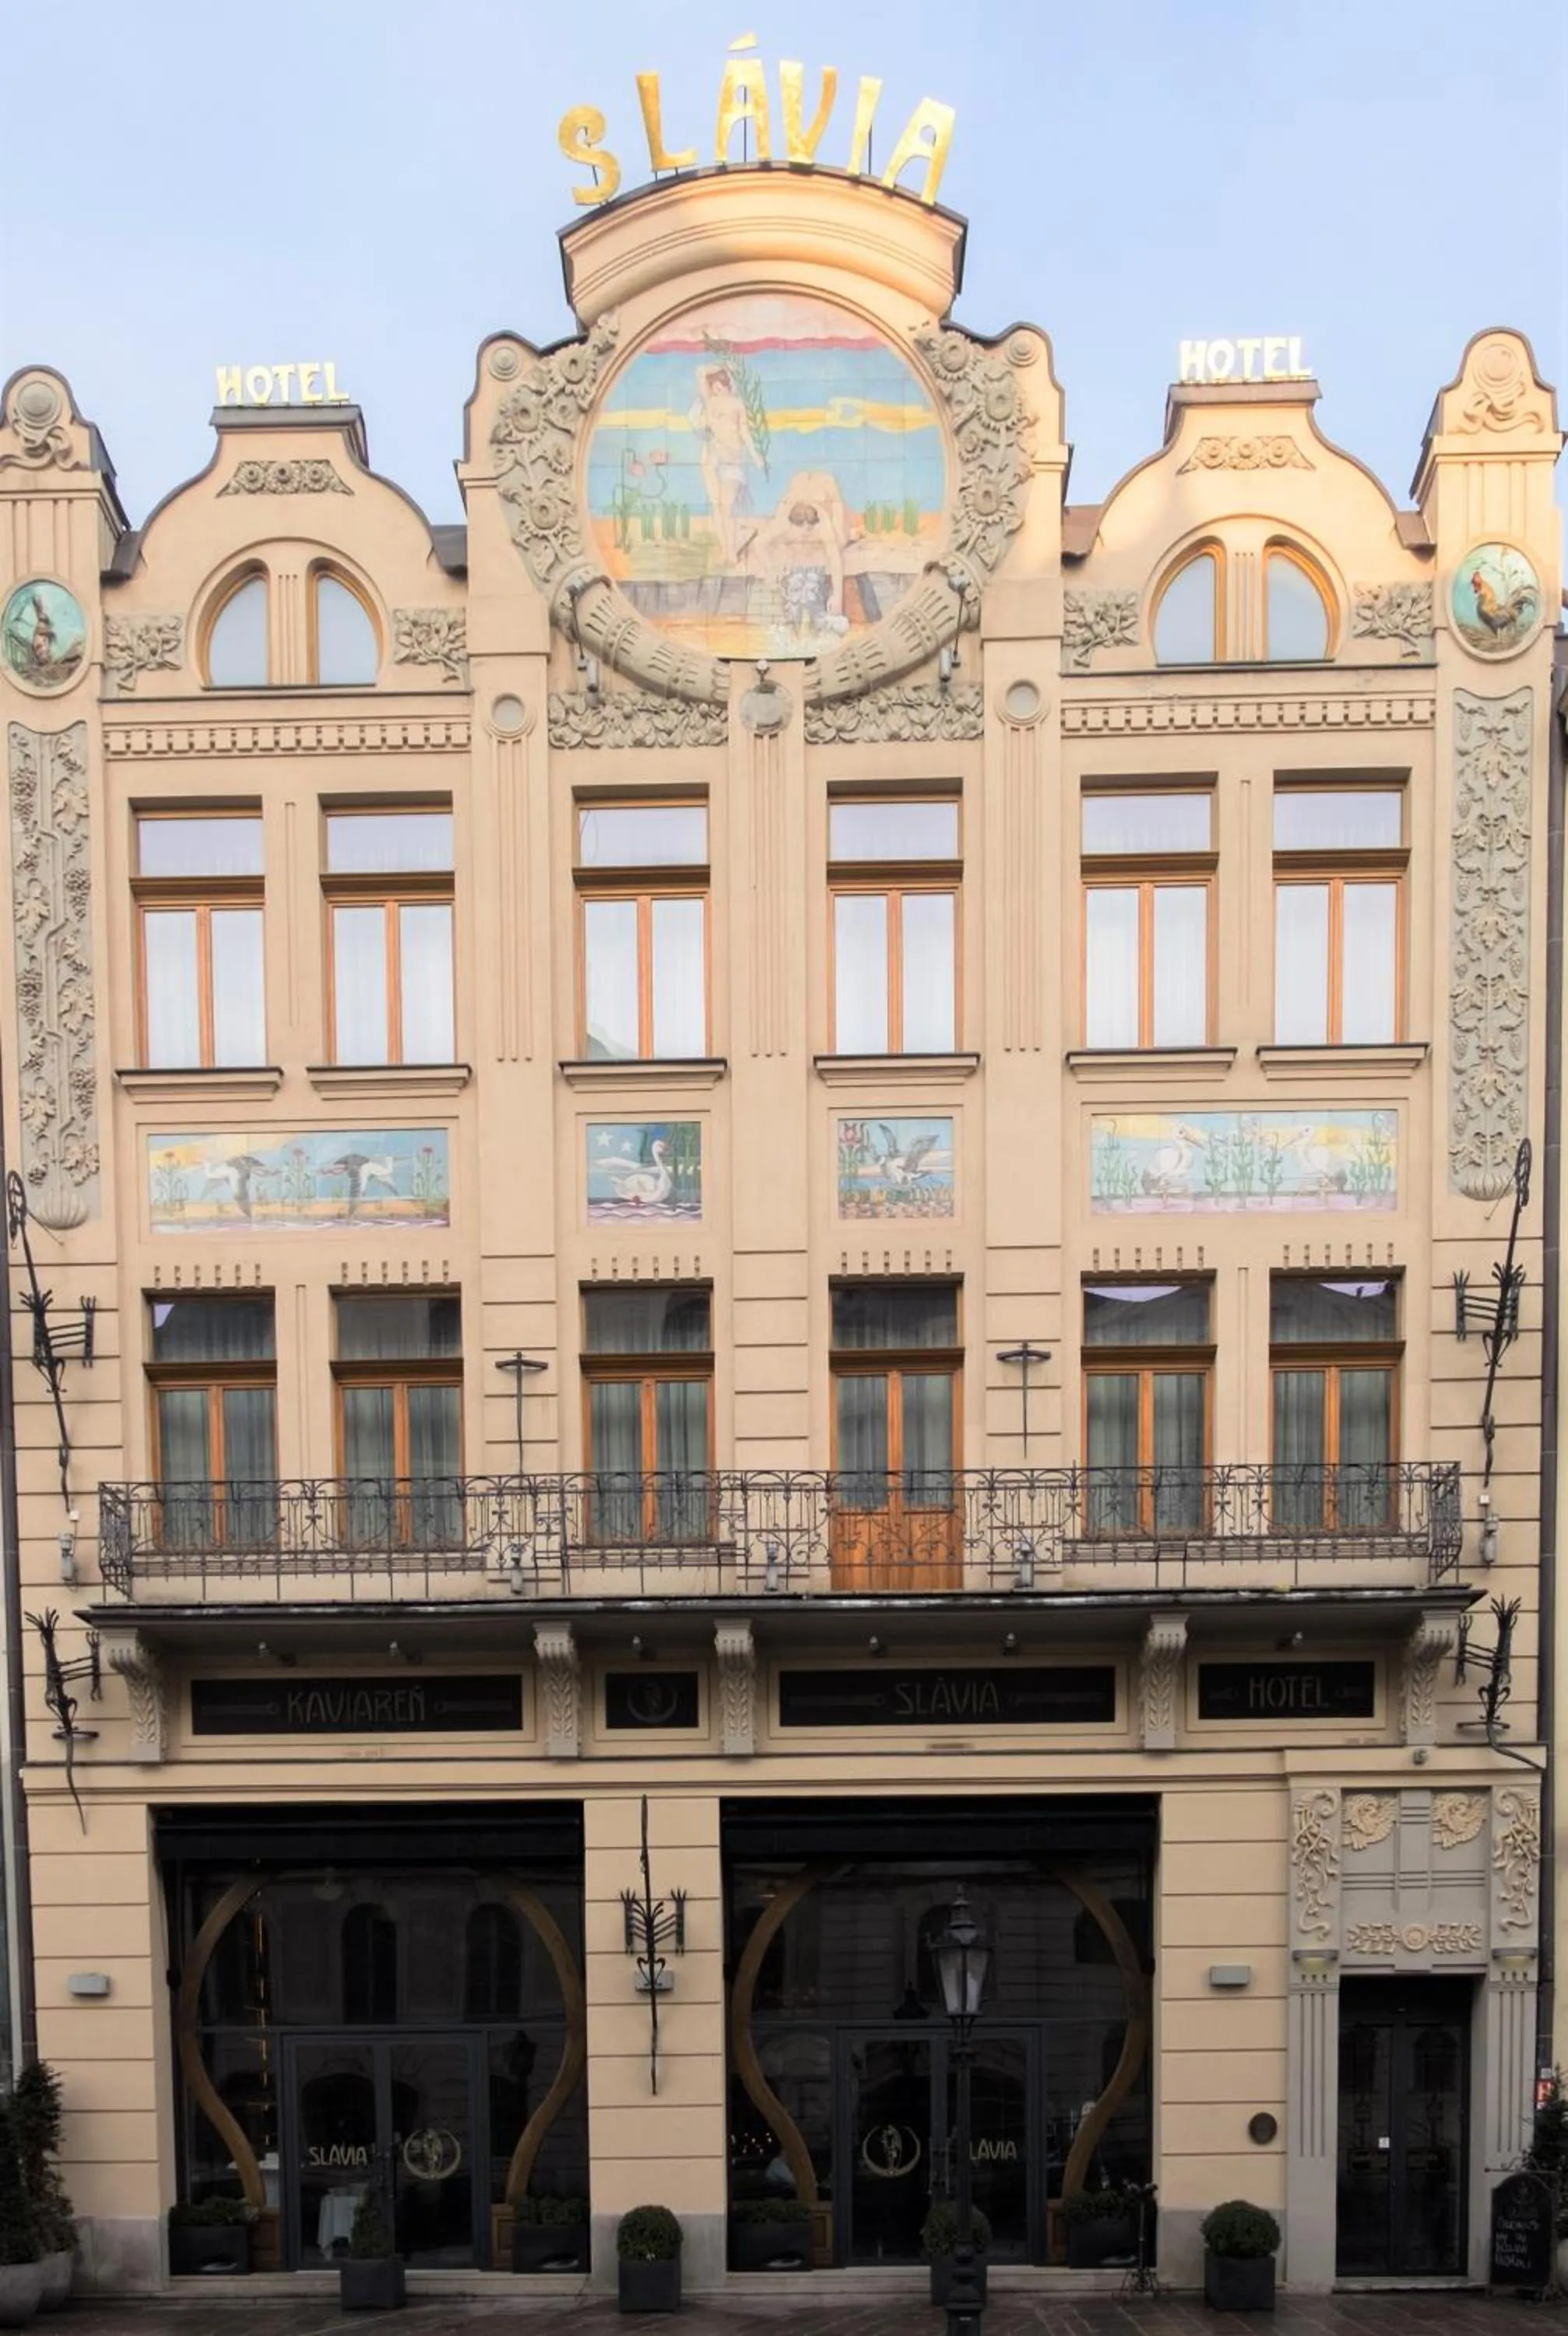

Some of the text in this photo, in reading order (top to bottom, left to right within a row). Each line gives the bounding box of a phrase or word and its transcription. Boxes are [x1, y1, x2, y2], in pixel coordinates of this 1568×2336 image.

[557, 32, 956, 206] SLÁVIA
[1179, 336, 1313, 384] HOTEL
[216, 361, 350, 406] HOTEL
[287, 1684, 426, 1725] KAVIAREŇ
[1249, 1675, 1330, 1709] HOTEL
